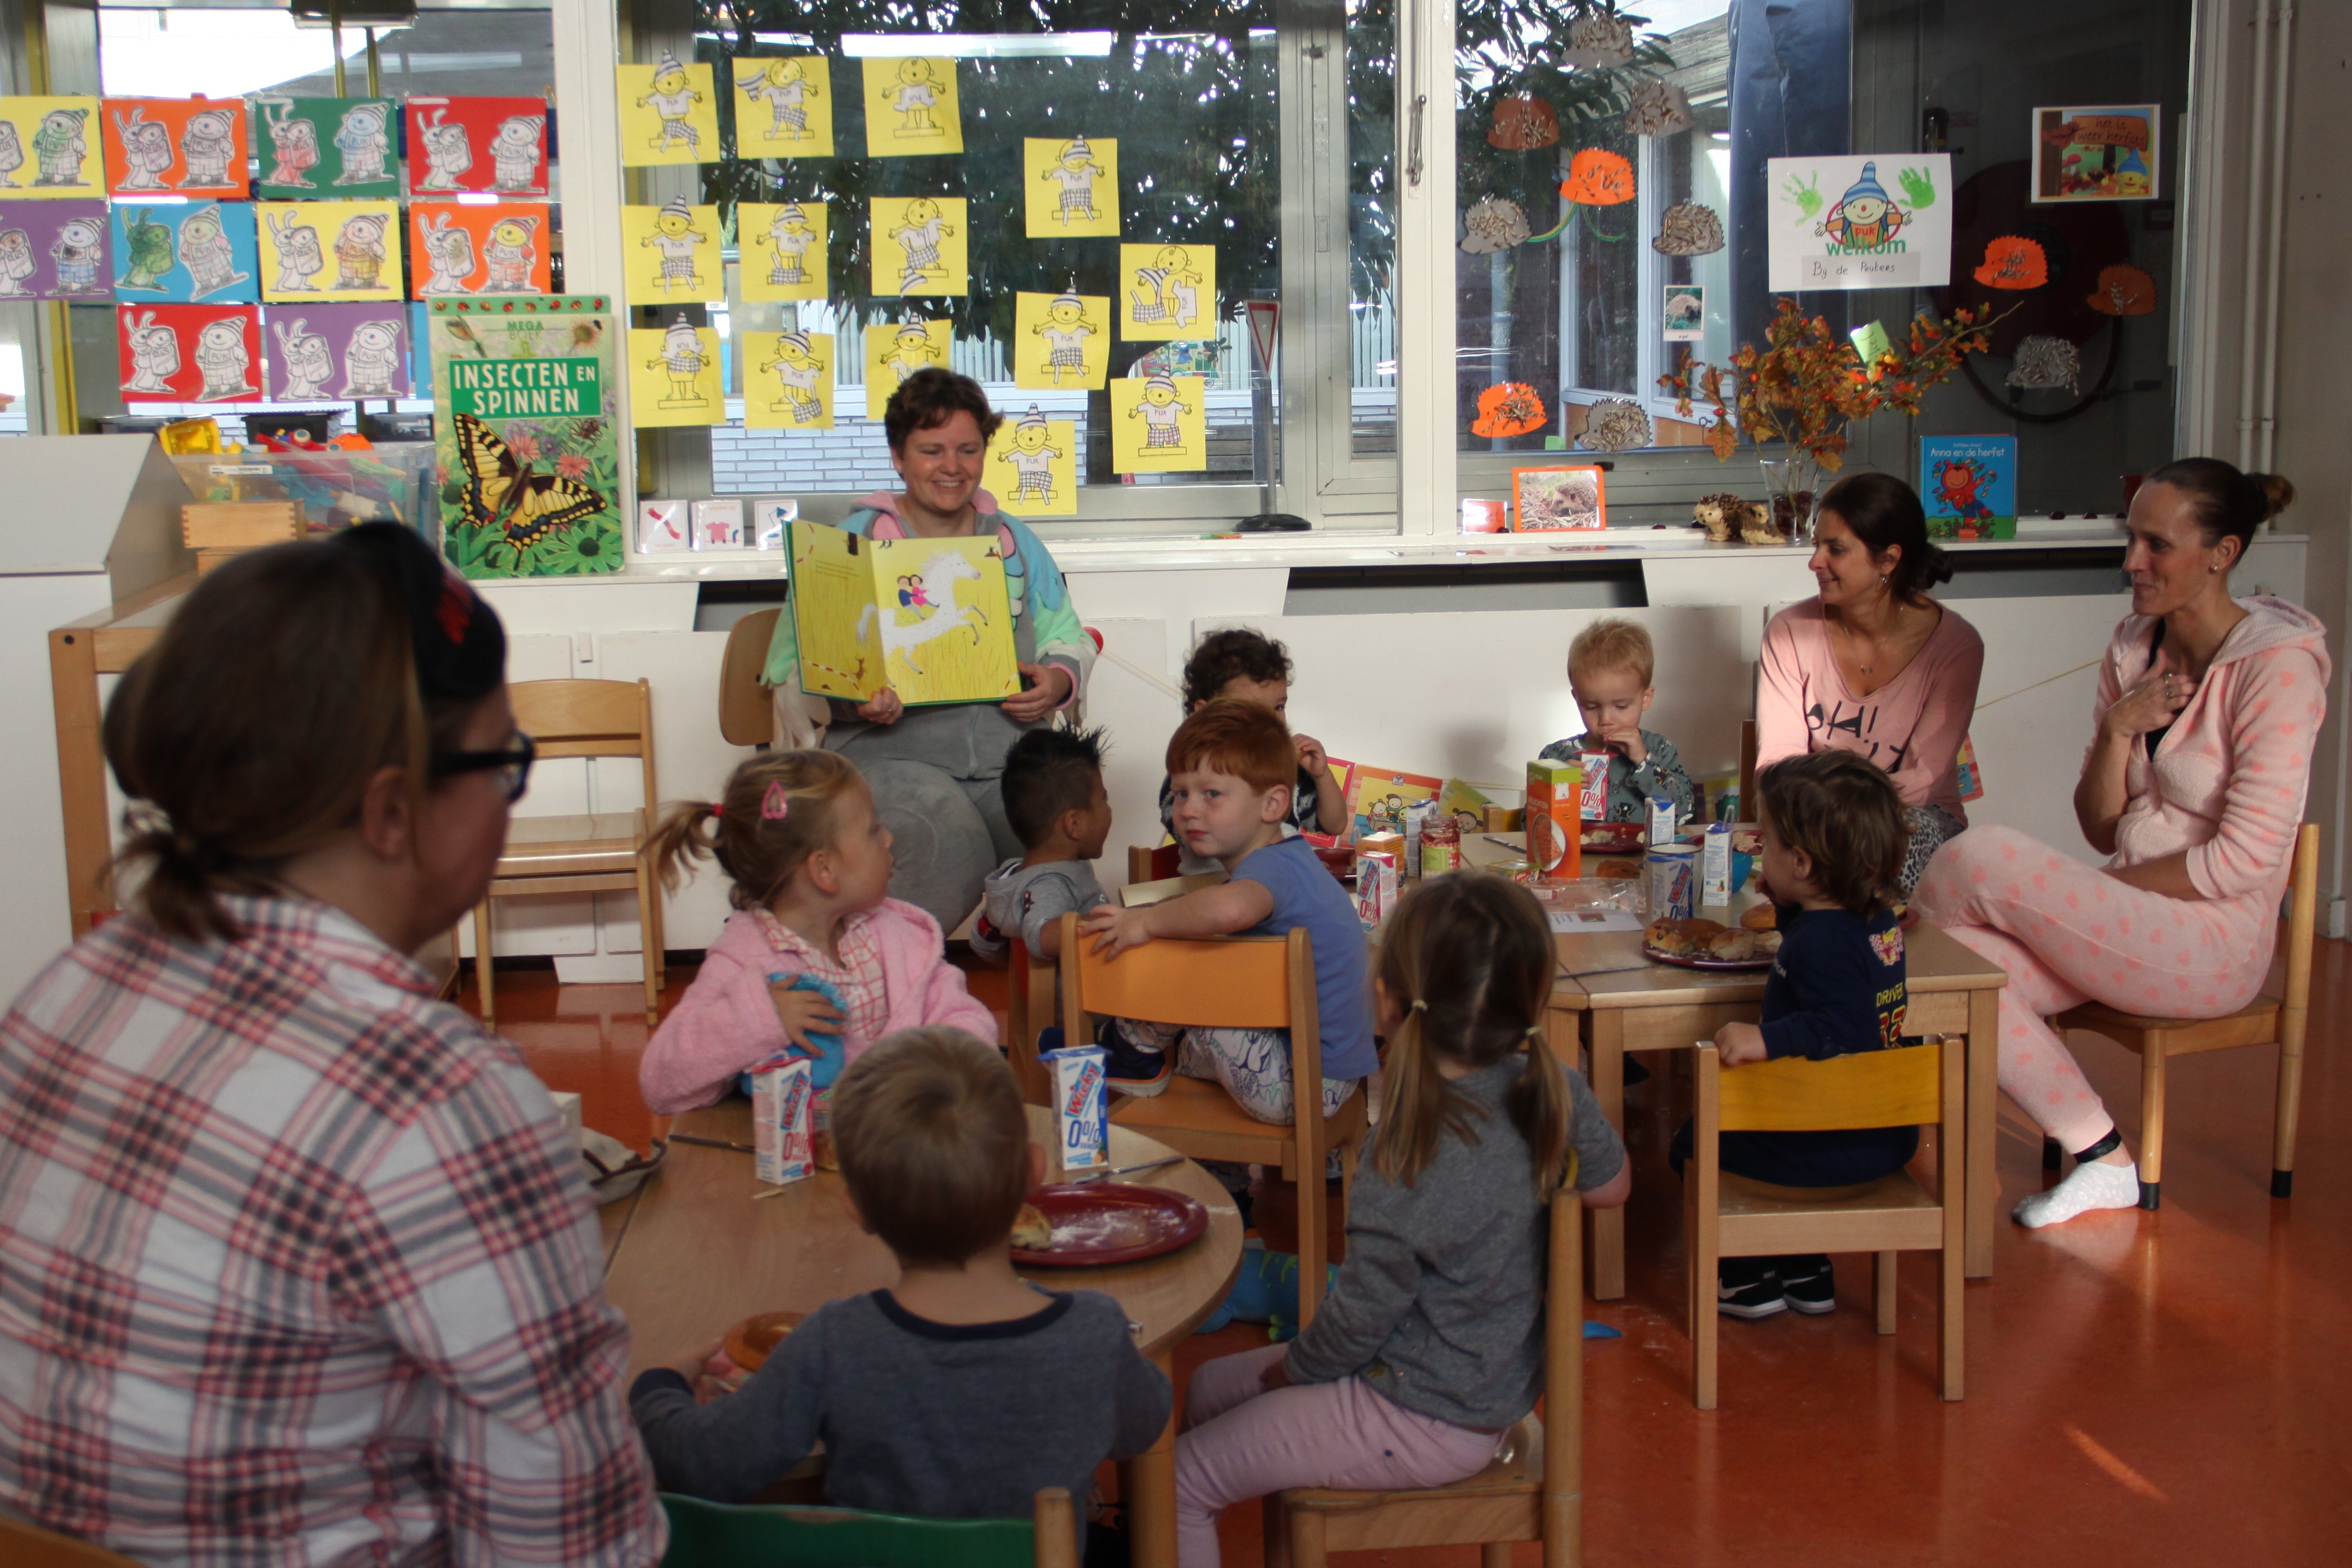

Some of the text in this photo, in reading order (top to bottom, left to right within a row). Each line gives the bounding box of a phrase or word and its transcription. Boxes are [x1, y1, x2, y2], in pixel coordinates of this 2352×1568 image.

[1854, 226, 1875, 237] puk
[1826, 236, 1906, 256] welkom
[1836, 265, 1849, 275] de
[507, 320, 544, 331] MEGA
[509, 331, 543, 341] BOEK
[454, 362, 595, 389] INSECTEN EN
[473, 388, 580, 416] SPINNEN
[1930, 448, 1951, 457] Anna
[1965, 449, 1977, 457] de
[1978, 447, 2006, 458] herfst
[1581, 791, 1601, 808] 0%
[1359, 864, 1378, 898] Wicky
[1669, 867, 1691, 902] Wicky
[1359, 899, 1378, 919] 0%
[1067, 1063, 1100, 1115] Wicky
[782, 1076, 807, 1127] Wicky
[1067, 1119, 1101, 1148] 0%
[783, 1131, 810, 1161] 0%
